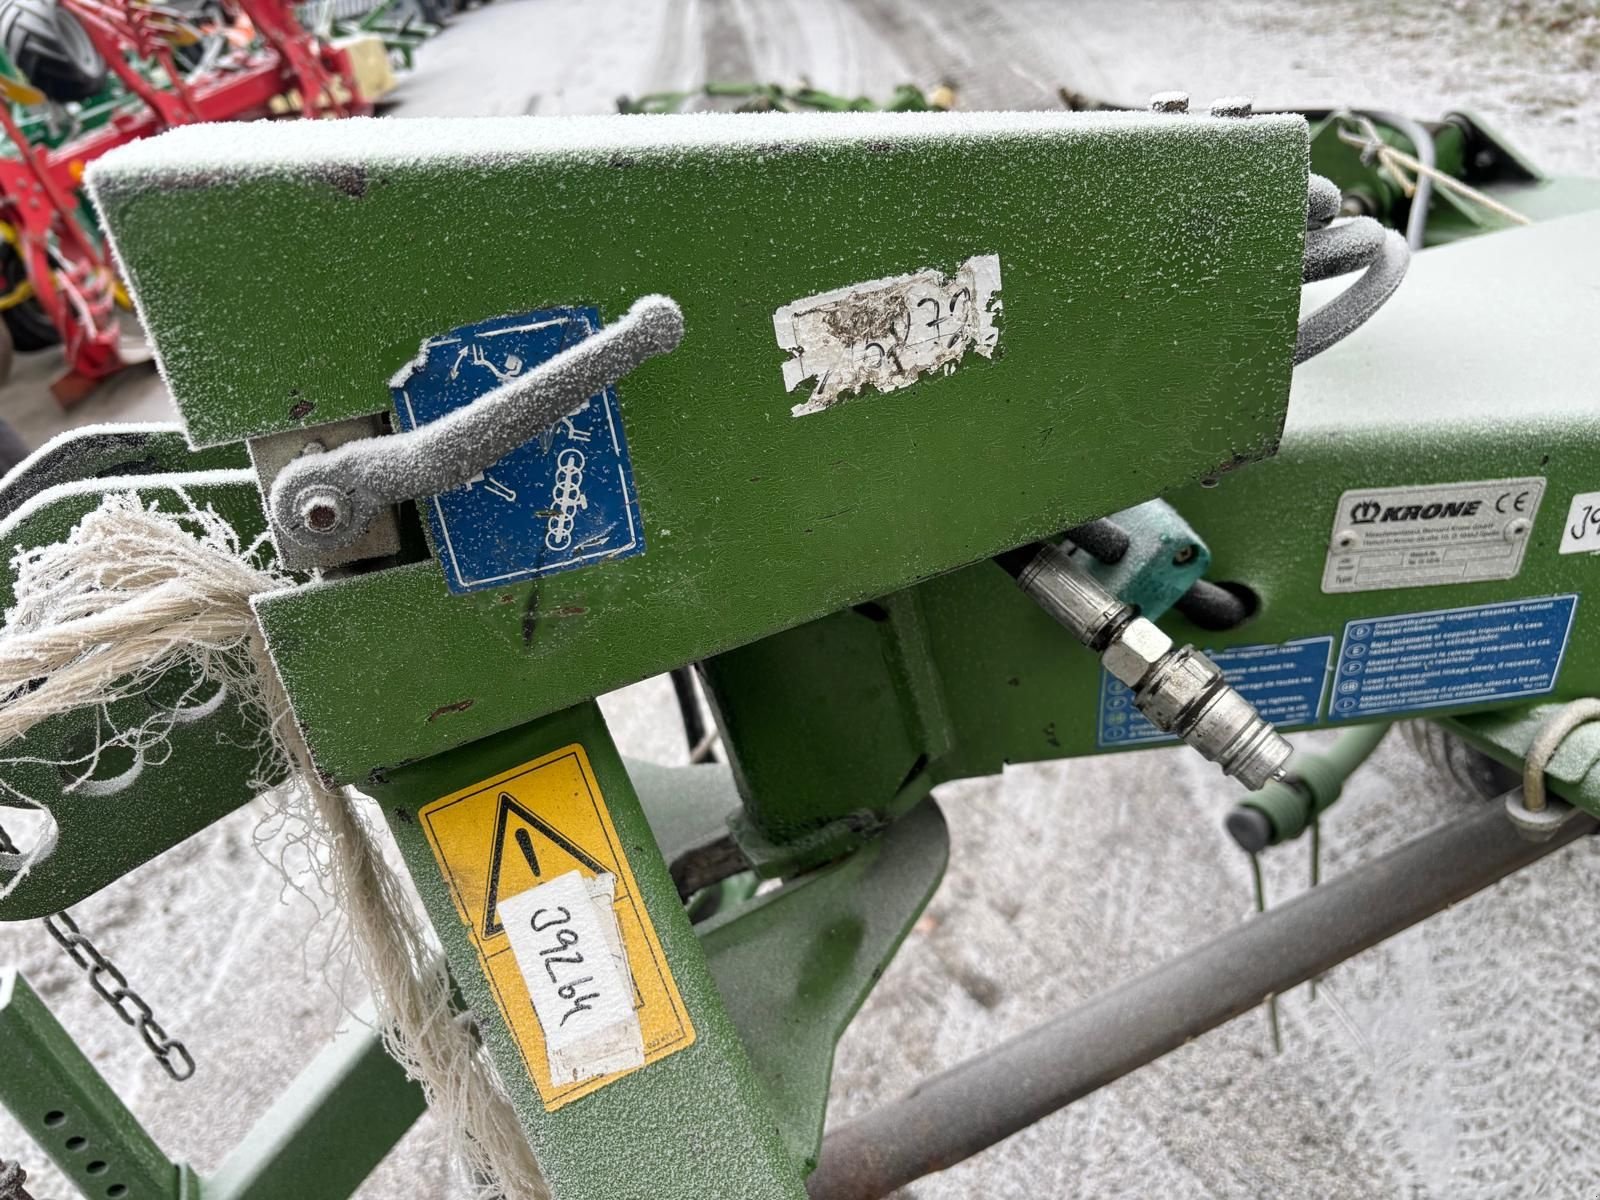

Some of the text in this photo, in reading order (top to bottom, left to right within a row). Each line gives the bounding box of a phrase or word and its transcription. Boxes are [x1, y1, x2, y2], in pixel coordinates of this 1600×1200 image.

[1380, 500, 1482, 522] KRONE
[1495, 492, 1529, 513] CE
[1363, 677, 1385, 685] Lower
